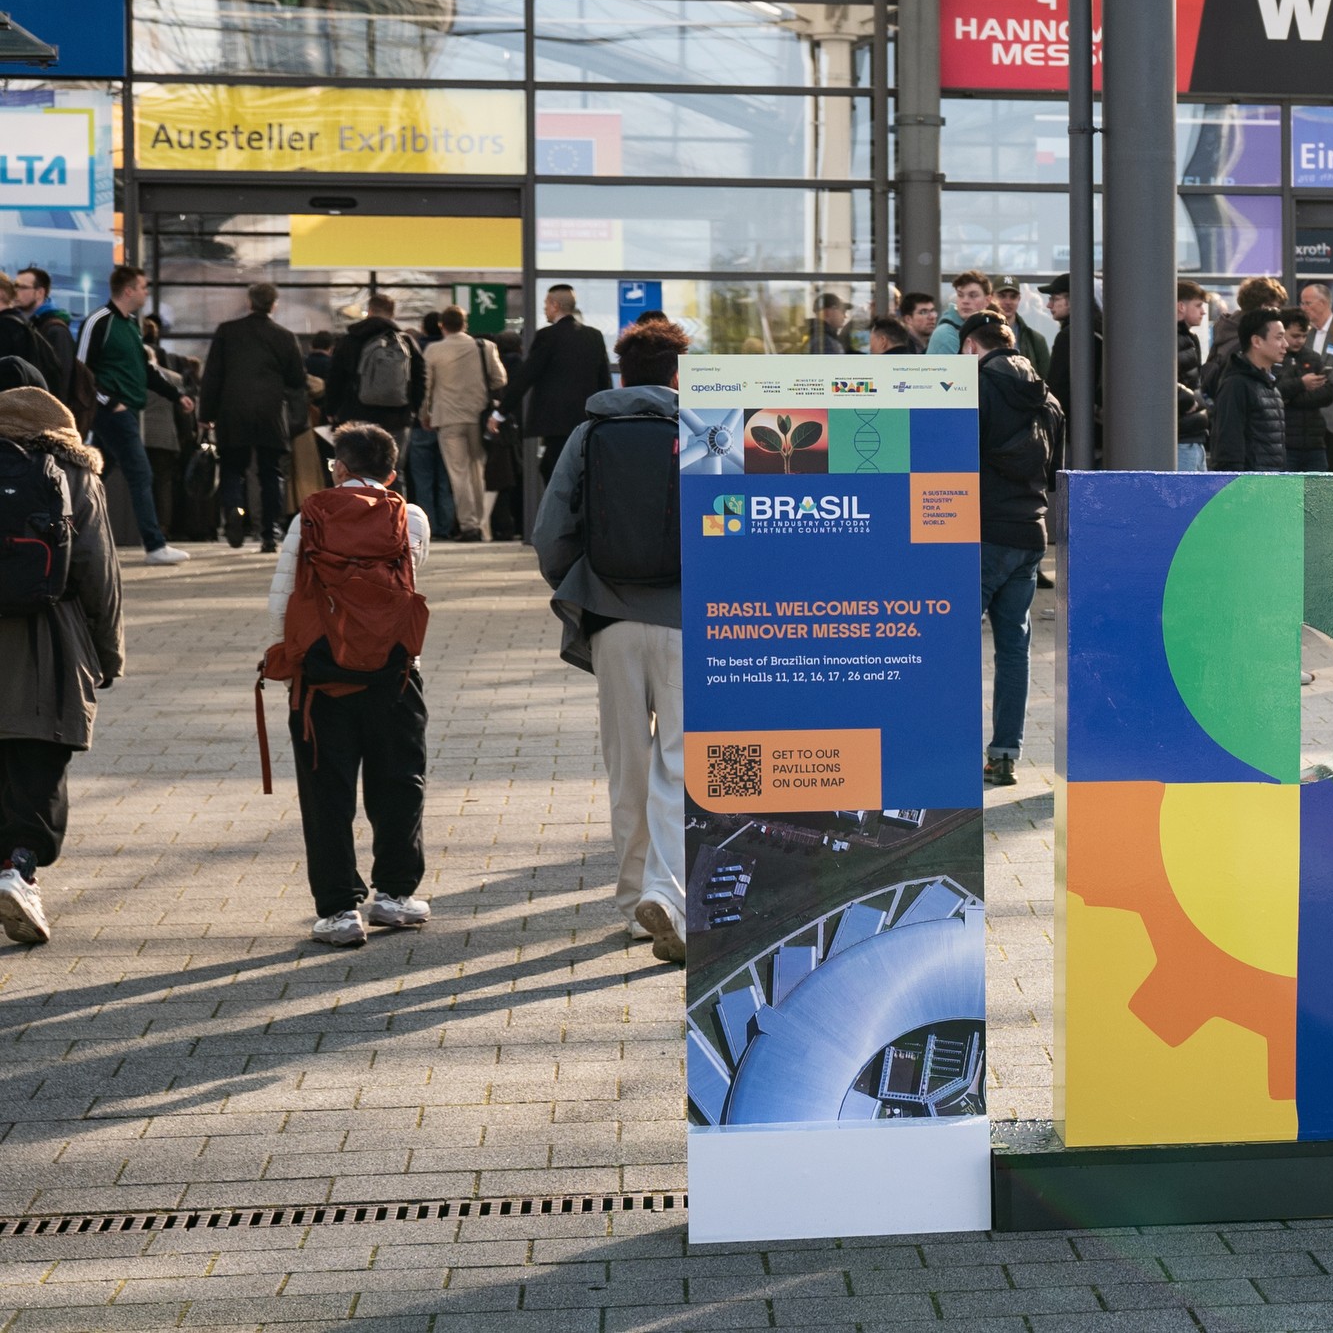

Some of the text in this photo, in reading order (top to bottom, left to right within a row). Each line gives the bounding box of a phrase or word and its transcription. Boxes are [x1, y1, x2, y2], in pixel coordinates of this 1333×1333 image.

[150, 123, 505, 155] Aussteller Exhibitors
[691, 383, 742, 393] apexBrasil
[750, 495, 871, 520] BRASIL
[706, 599, 952, 617] BRASIL WELCOMES YOU TO
[706, 622, 922, 640] HANNOVER MESSE 2026.
[706, 654, 922, 667] The best of Brazilian innovation awaits
[706, 674, 727, 685] you
[729, 673, 740, 683] in
[742, 672, 773, 683] Halls
[775, 672, 790, 683] 11,
[793, 672, 807, 683] 12,
[810, 672, 825, 683] 16,
[848, 671, 861, 681] 26
[863, 671, 885, 681] and
[887, 670, 901, 680] 27.
[772, 749, 840, 760] GET TO OUR
[772, 763, 841, 774] PAVILLIONS
[772, 777, 845, 788] ON OUR MAP
